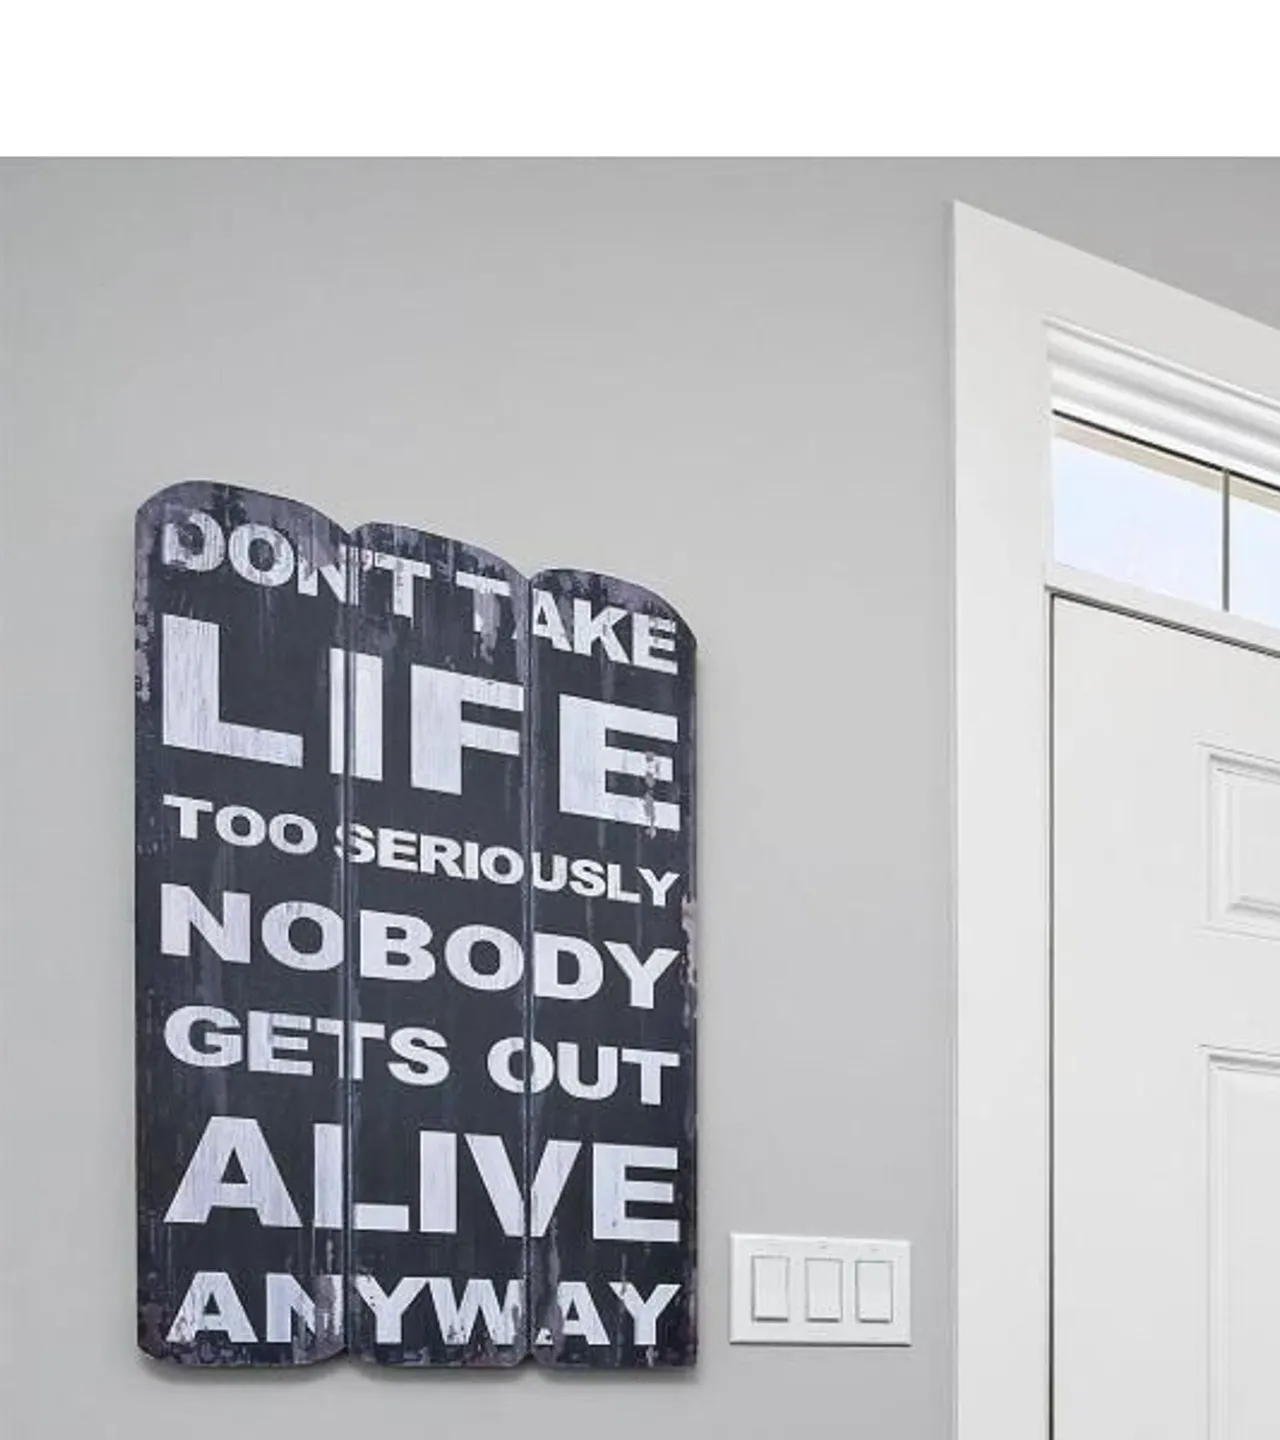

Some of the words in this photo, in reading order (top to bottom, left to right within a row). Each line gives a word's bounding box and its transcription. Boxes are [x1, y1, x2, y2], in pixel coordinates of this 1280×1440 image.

[162, 511, 430, 618] DON'T
[456, 571, 678, 675] TAKE
[162, 616, 680, 831] LIFE
[163, 795, 318, 855] TOO
[334, 821, 680, 907] SERIOUSLY
[160, 882, 680, 1010] NOBODY
[163, 1004, 450, 1086] GETS
[486, 1036, 680, 1105] OUT
[163, 1115, 680, 1242] ALIVE
[165, 1271, 681, 1346] ANYWAY
